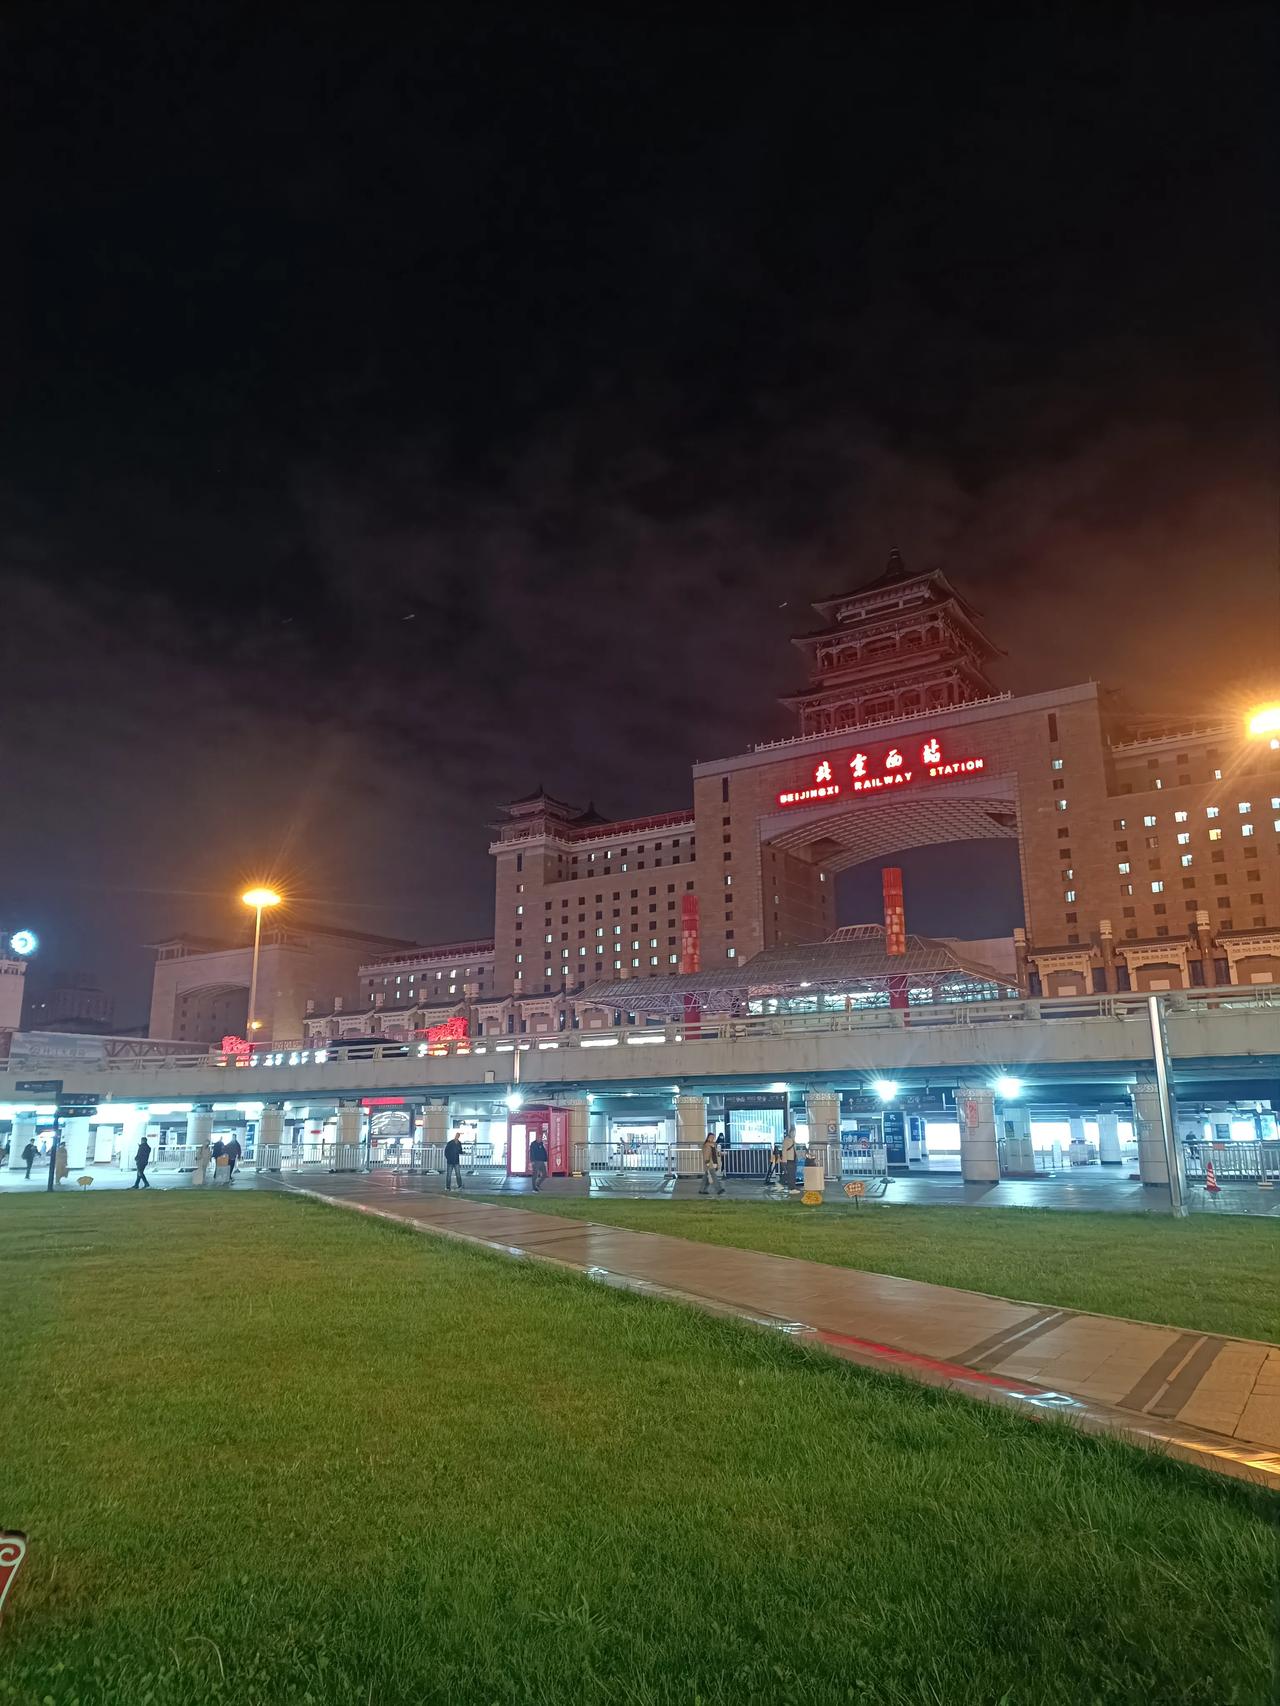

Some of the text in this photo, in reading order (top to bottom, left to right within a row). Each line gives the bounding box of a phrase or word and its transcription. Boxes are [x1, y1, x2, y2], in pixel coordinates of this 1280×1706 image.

[779, 759, 984, 804] BEIJINGXI RAILWAY STATION
[815, 738, 941, 783] 北京西站
